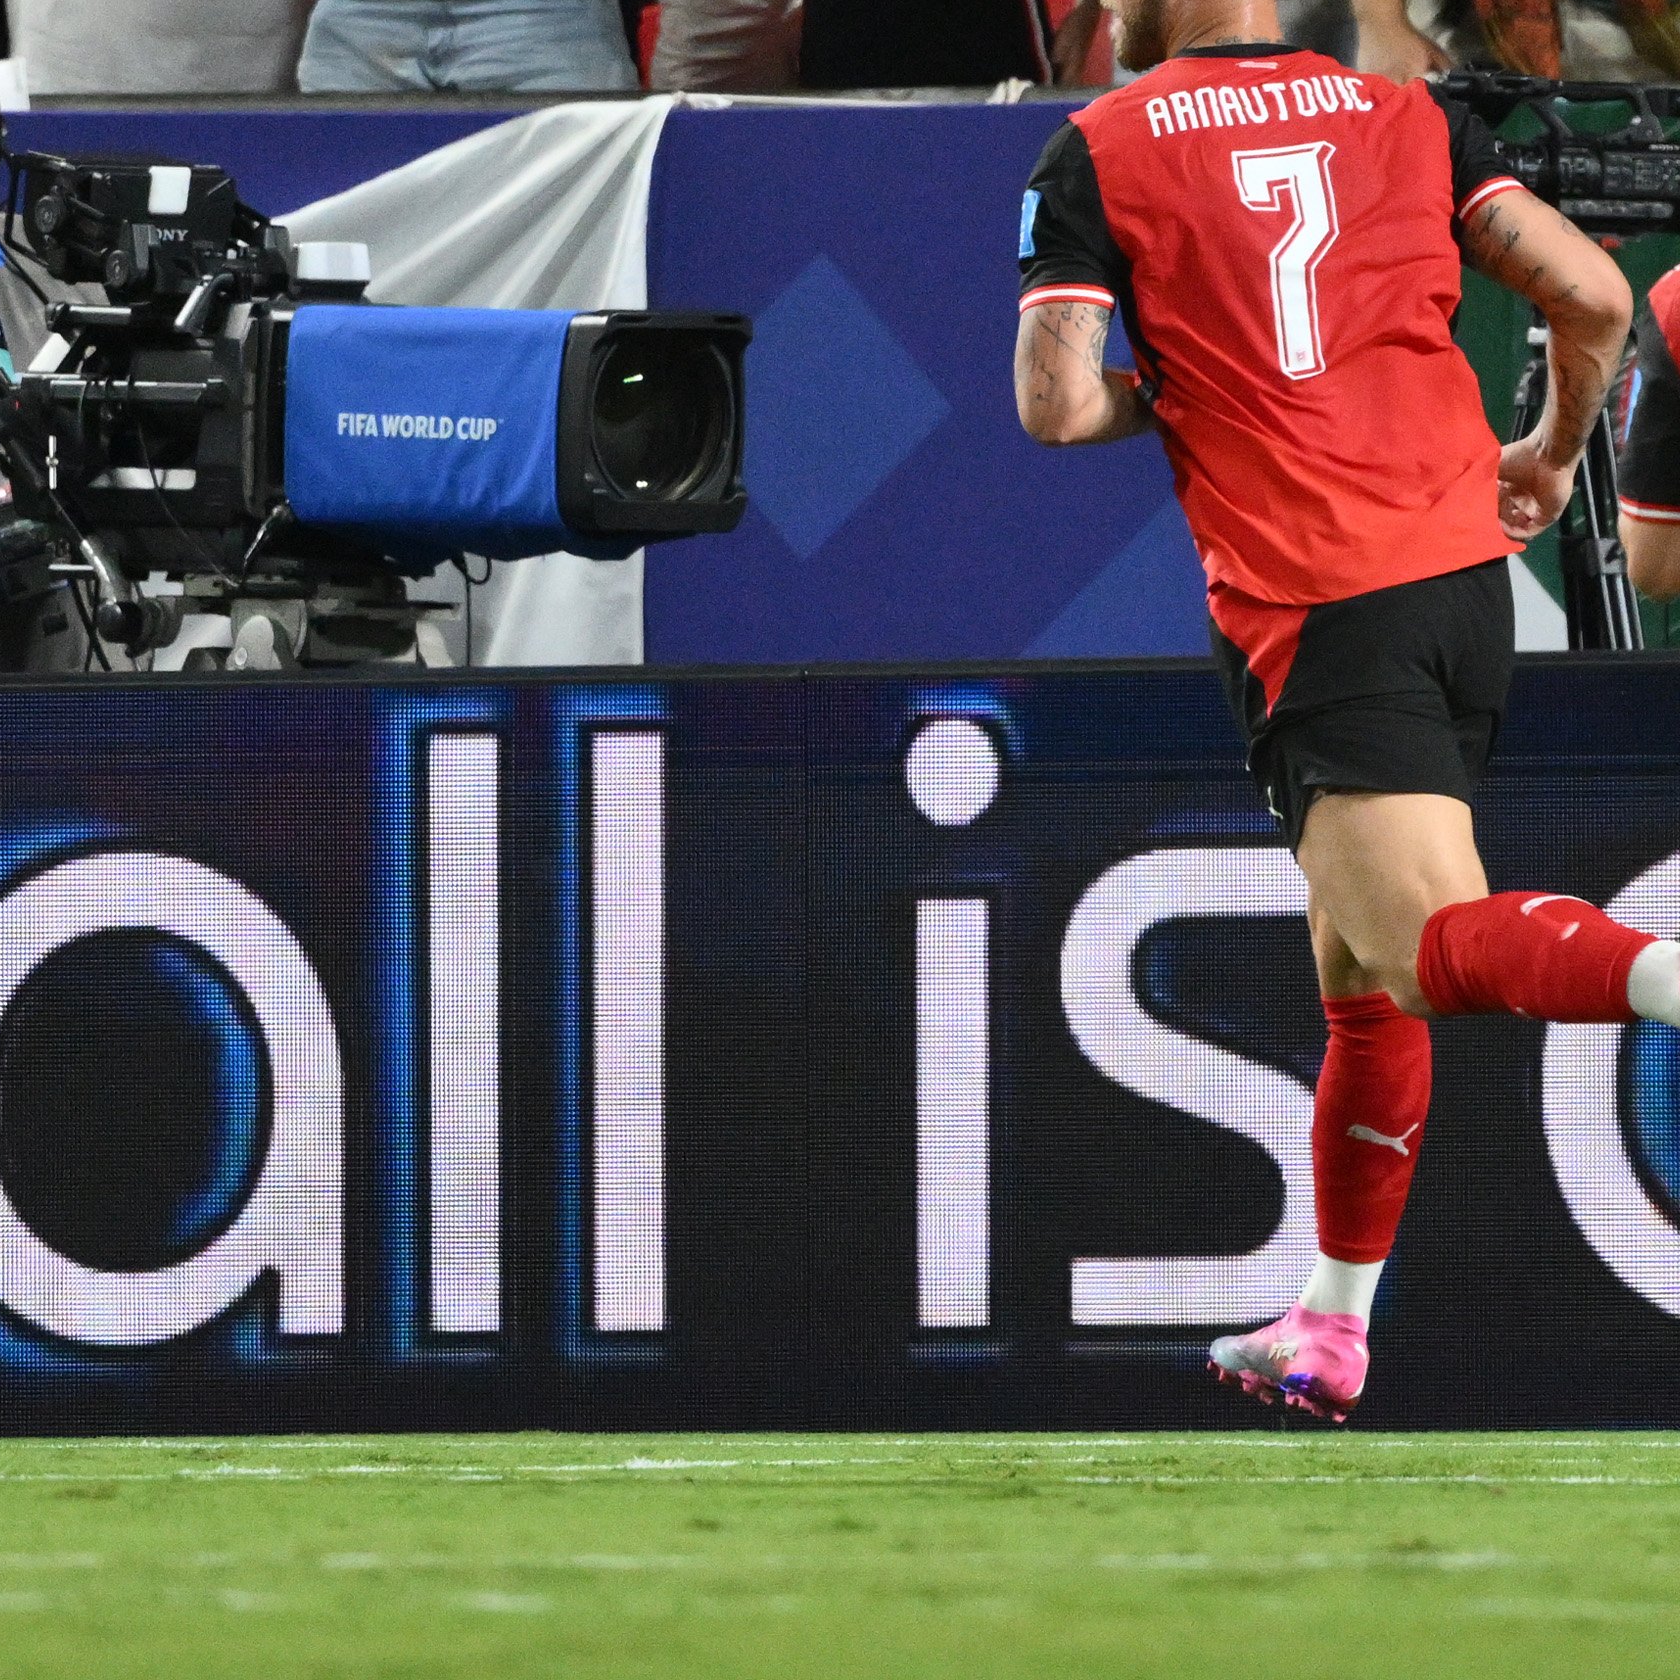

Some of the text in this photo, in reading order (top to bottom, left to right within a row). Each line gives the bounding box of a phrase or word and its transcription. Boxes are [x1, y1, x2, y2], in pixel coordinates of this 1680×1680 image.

[1145, 75, 1374, 138] ARNAUTOVIC
[155, 228, 189, 241] NY
[1231, 140, 1340, 380] 7
[338, 413, 497, 441] FIFA WORLD CUP
[906, 716, 1321, 1330] is
